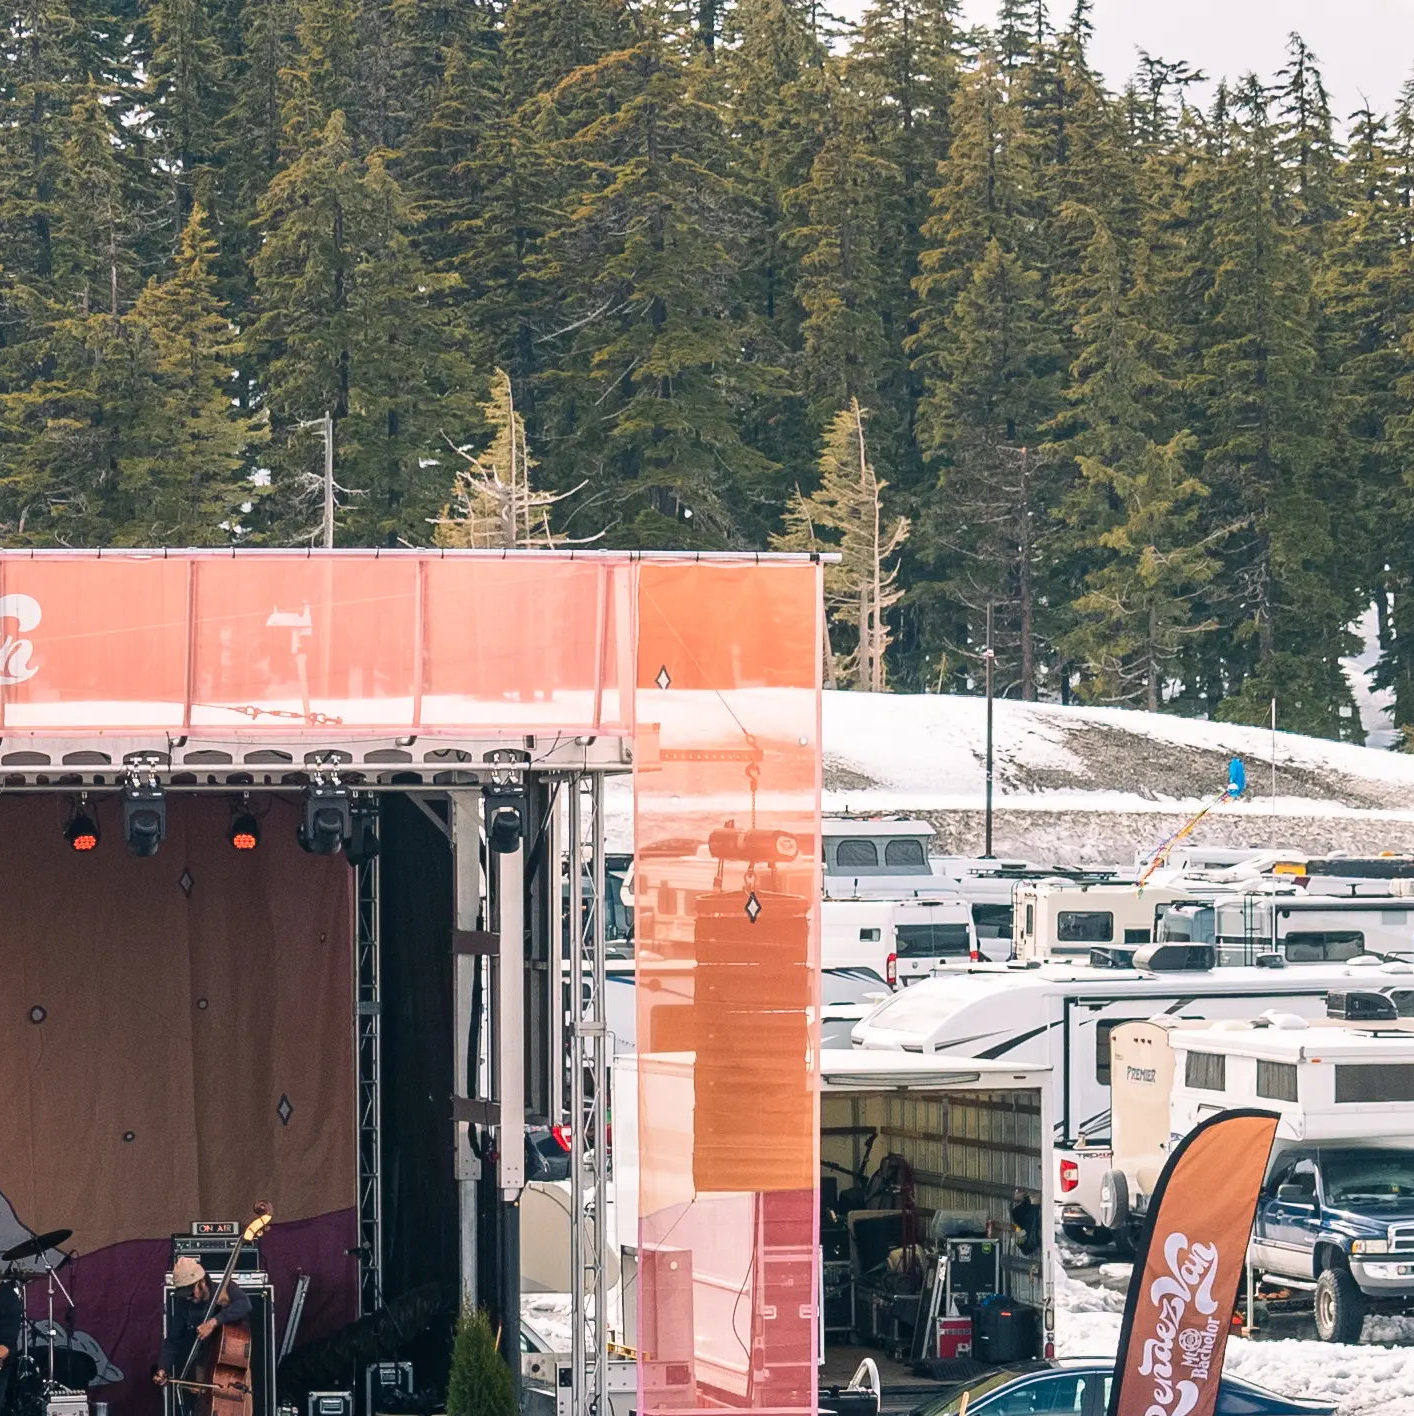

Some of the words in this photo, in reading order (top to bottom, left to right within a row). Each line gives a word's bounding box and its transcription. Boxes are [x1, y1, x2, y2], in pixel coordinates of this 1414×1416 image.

[199, 1224, 214, 1233] ON
[217, 1224, 232, 1233] AIR
[1190, 1316, 1220, 1381] Bachelor
